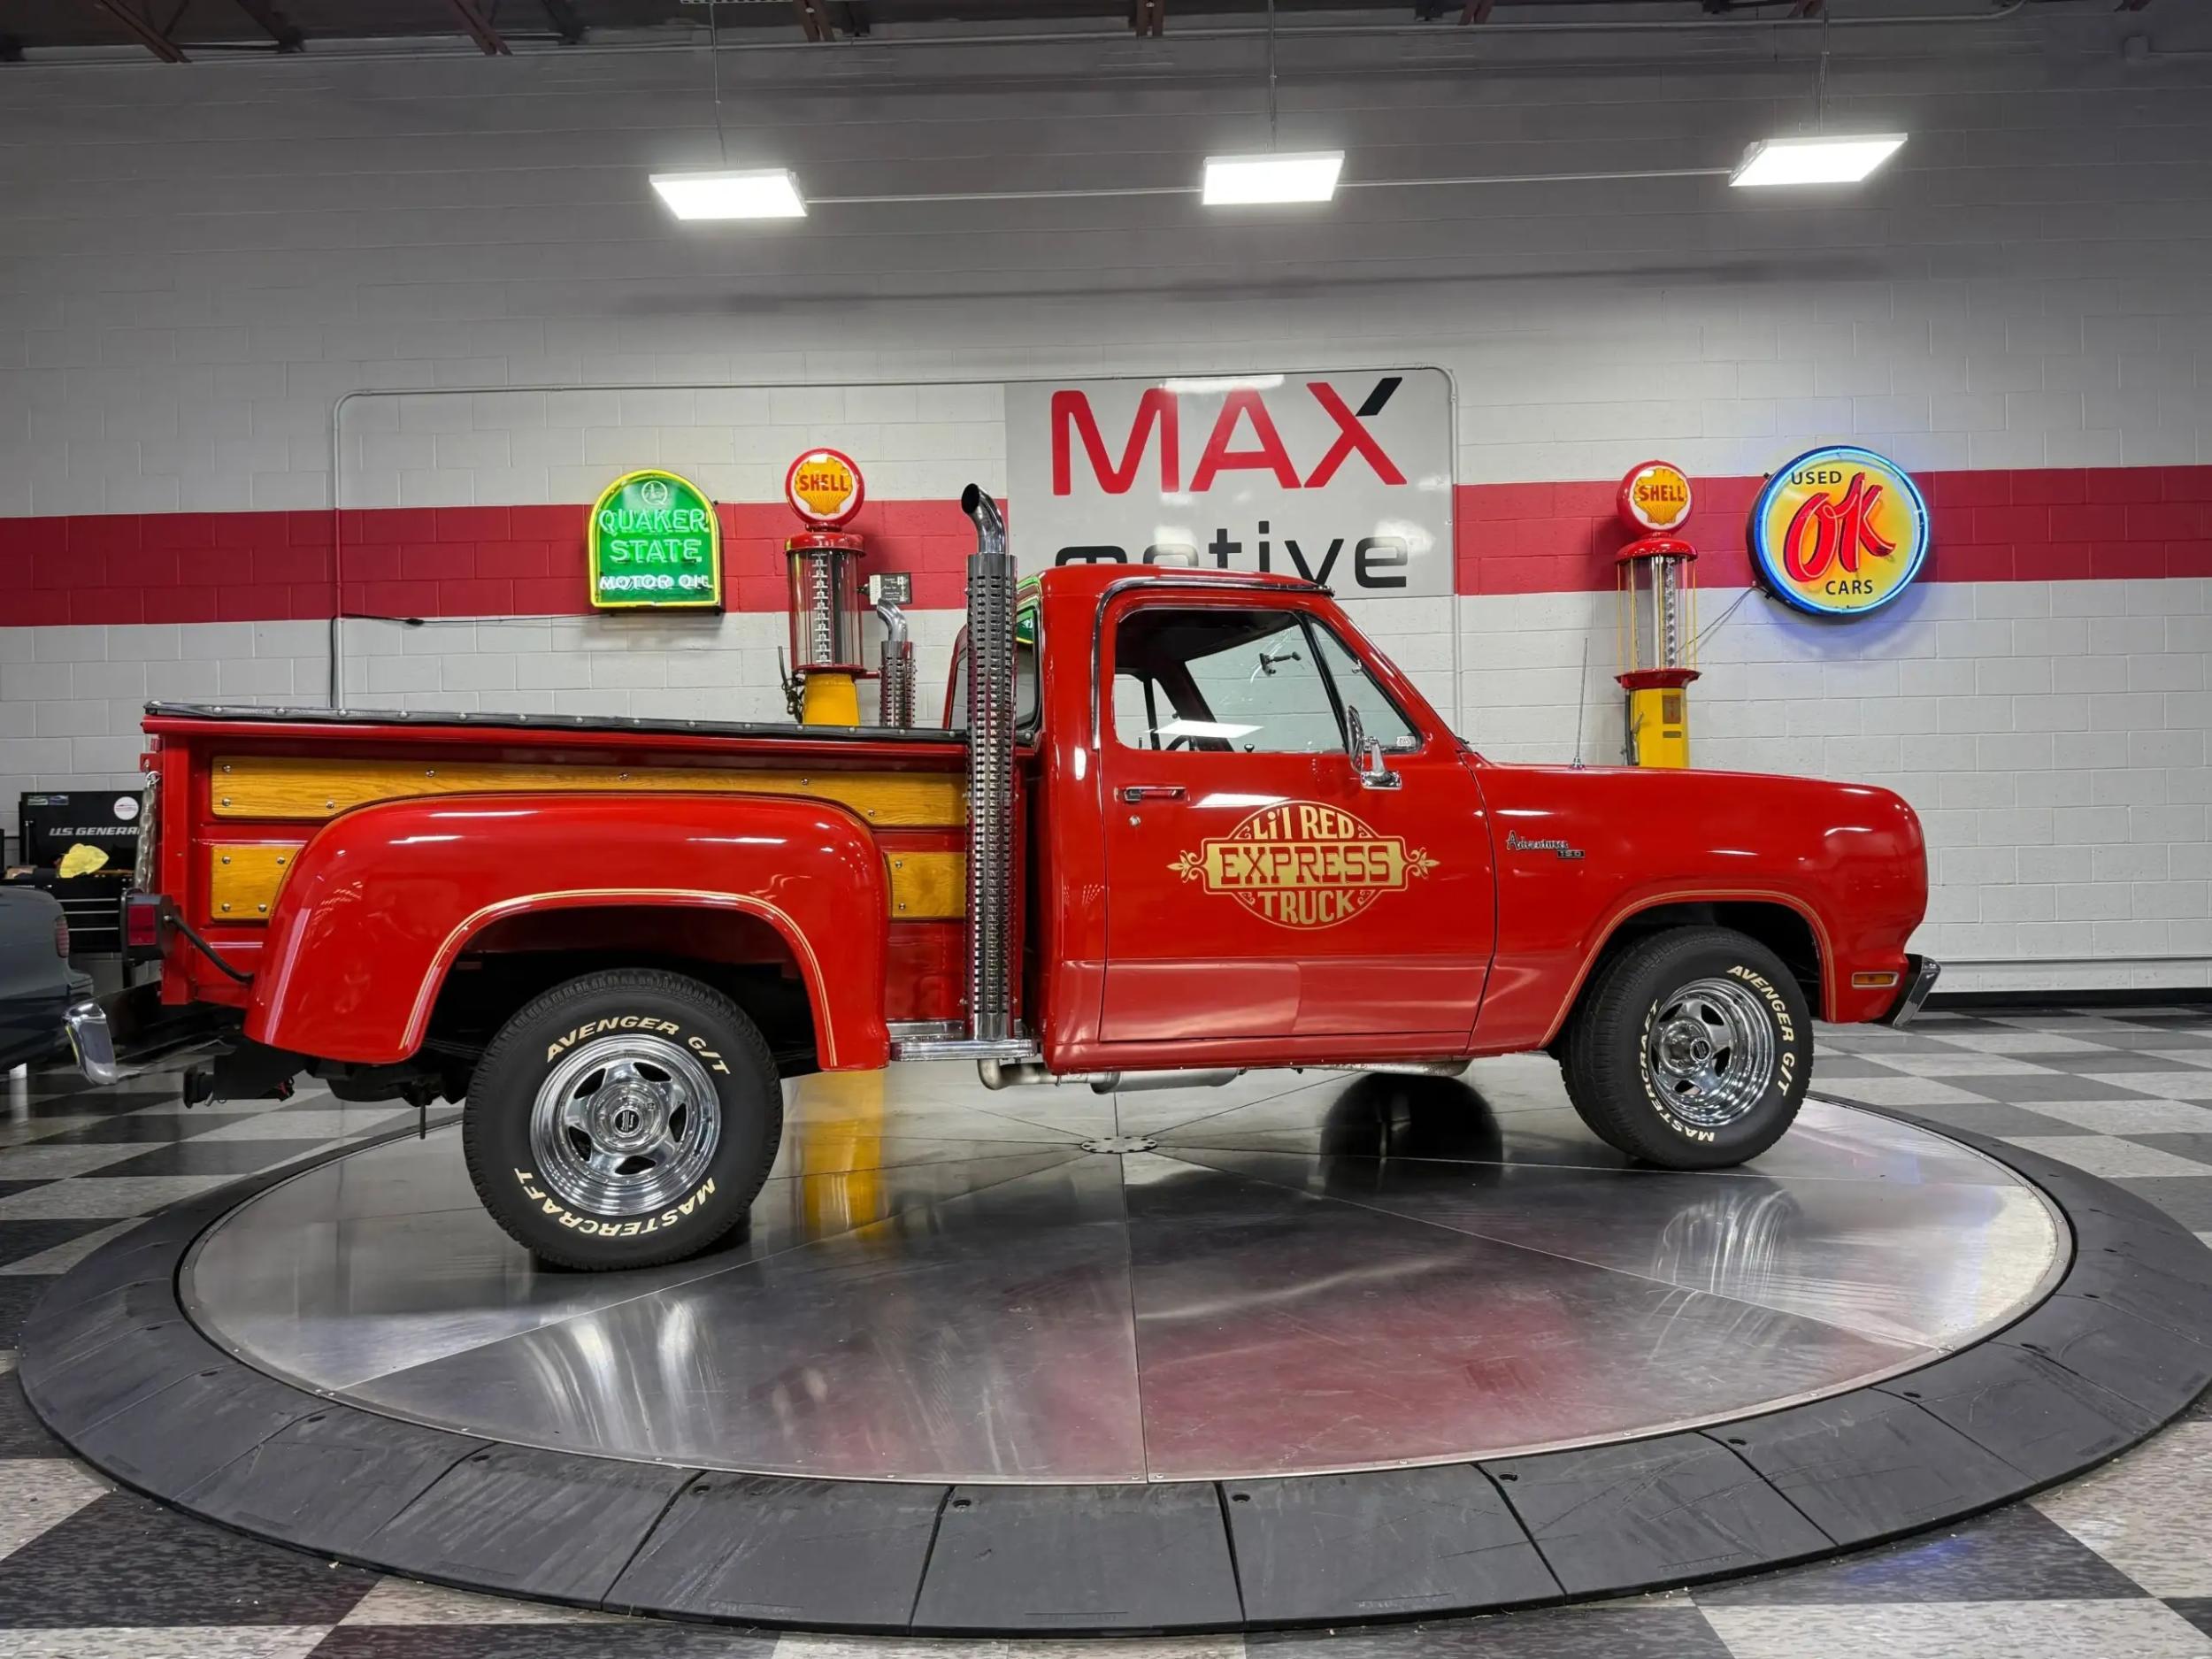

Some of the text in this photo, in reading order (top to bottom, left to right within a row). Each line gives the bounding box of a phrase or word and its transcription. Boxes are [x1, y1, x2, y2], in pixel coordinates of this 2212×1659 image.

[1051, 376, 1408, 496] MAX
[799, 473, 849, 492] SHELL
[1638, 484, 1685, 503] SHELL
[1791, 471, 1842, 485] USED
[599, 508, 710, 537] QUAKER
[1783, 472, 1896, 583] OK
[609, 538, 703, 563] STATE
[599, 574, 713, 590] MOTOR OIL
[1825, 580, 1873, 595] CARS
[75, 826, 141, 836] GENERA
[1299, 805, 1355, 839] RED
[1218, 845, 1389, 885] EXPRESS
[1258, 889, 1356, 924] TRUCK
[1726, 965, 1794, 1042] AVENGER
[547, 1015, 680, 1063] AVENGER
[1640, 999, 1715, 1142] MASTERCRAFT
[513, 1167, 717, 1237] MASTERCRAFT
